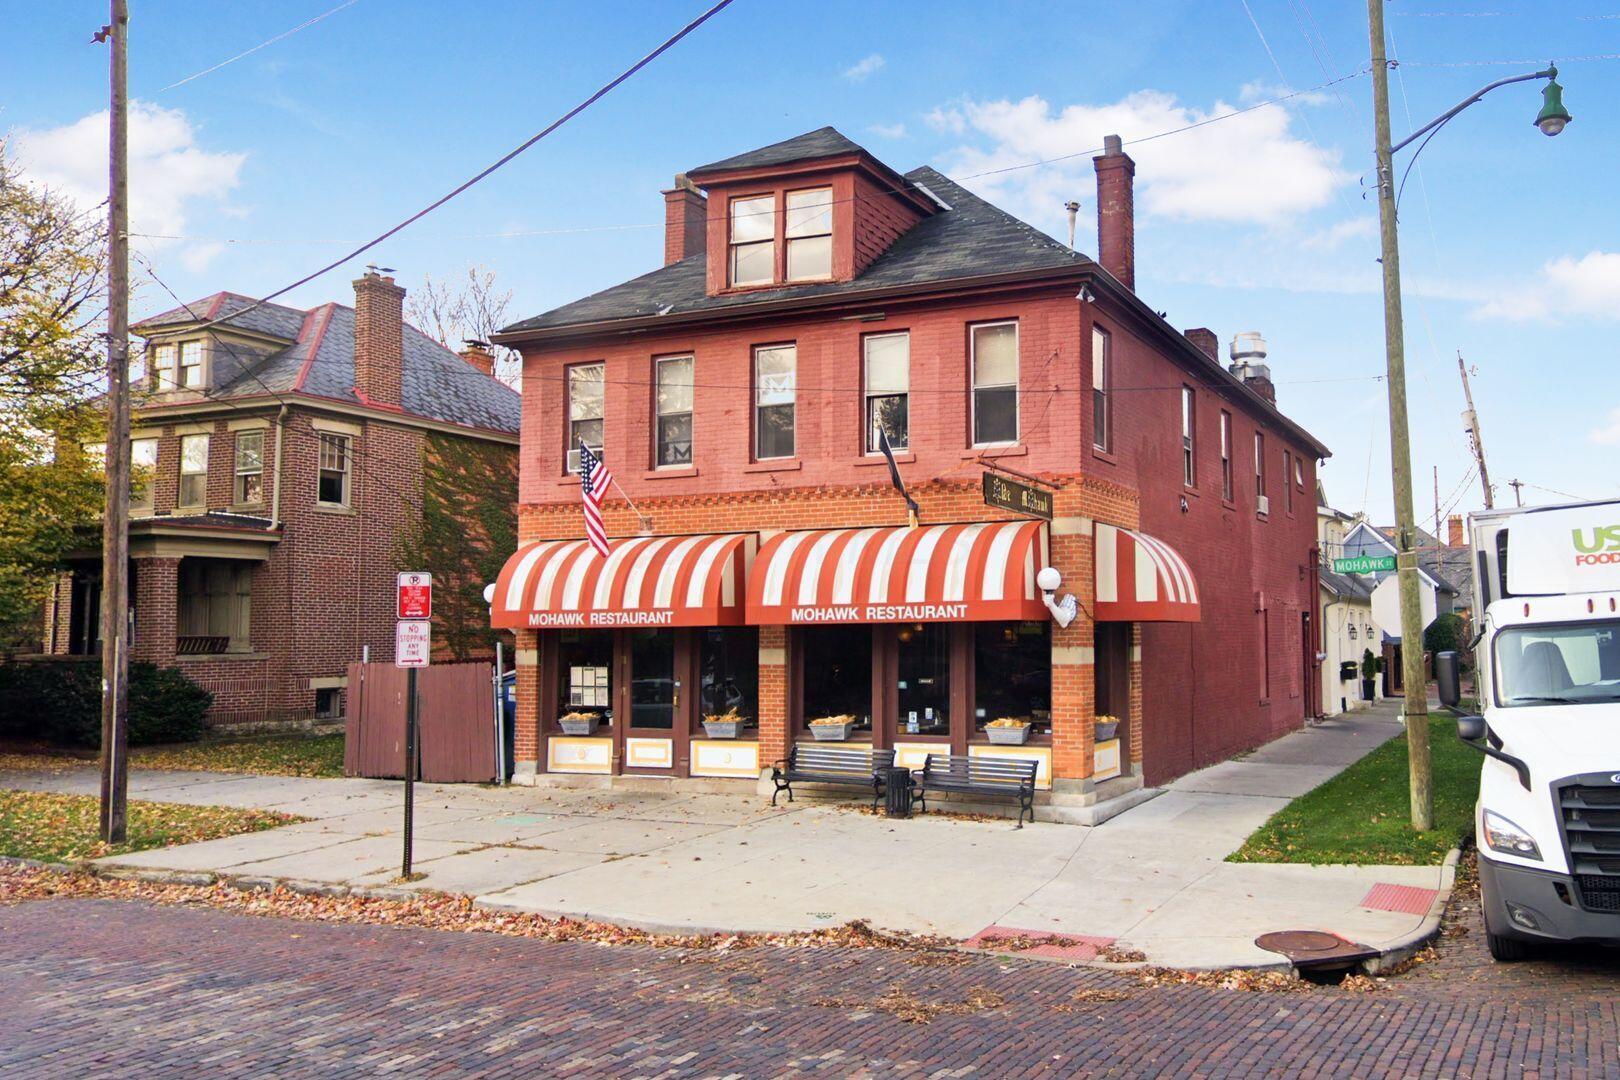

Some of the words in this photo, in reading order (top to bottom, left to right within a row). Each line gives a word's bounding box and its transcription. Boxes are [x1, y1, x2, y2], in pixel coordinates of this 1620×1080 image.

[1572, 525, 1620, 553] US
[1336, 559, 1385, 571] MOHAWK
[528, 613, 584, 625] MOHAWK
[590, 611, 674, 625] RESTAURANT
[791, 607, 859, 621] MOHAWK
[866, 604, 967, 620] RESTAURANT
[408, 625, 419, 633] NO
